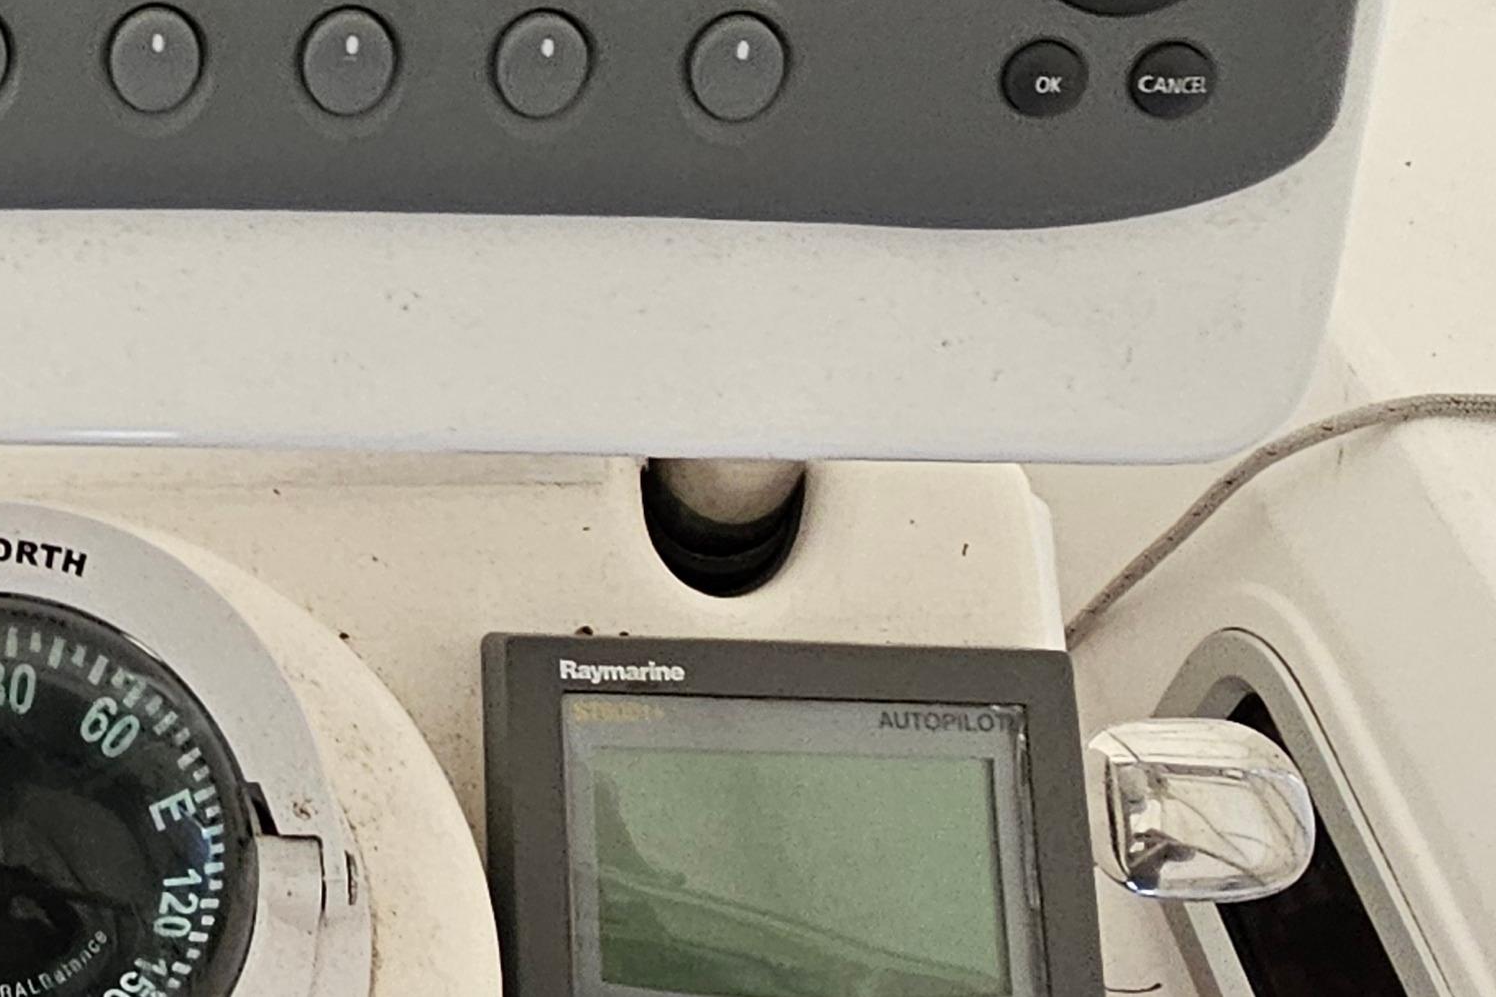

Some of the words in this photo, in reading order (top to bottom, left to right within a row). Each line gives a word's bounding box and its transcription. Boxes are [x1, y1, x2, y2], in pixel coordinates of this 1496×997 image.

[1034, 75, 1063, 94] OK
[1137, 74, 1208, 94] CANCEL
[559, 658, 686, 684] Raymarine
[80, 696, 140, 758] 60
[878, 710, 1012, 733] AUTOPILOT
[148, 788, 197, 832] E
[153, 867, 203, 938] 120
